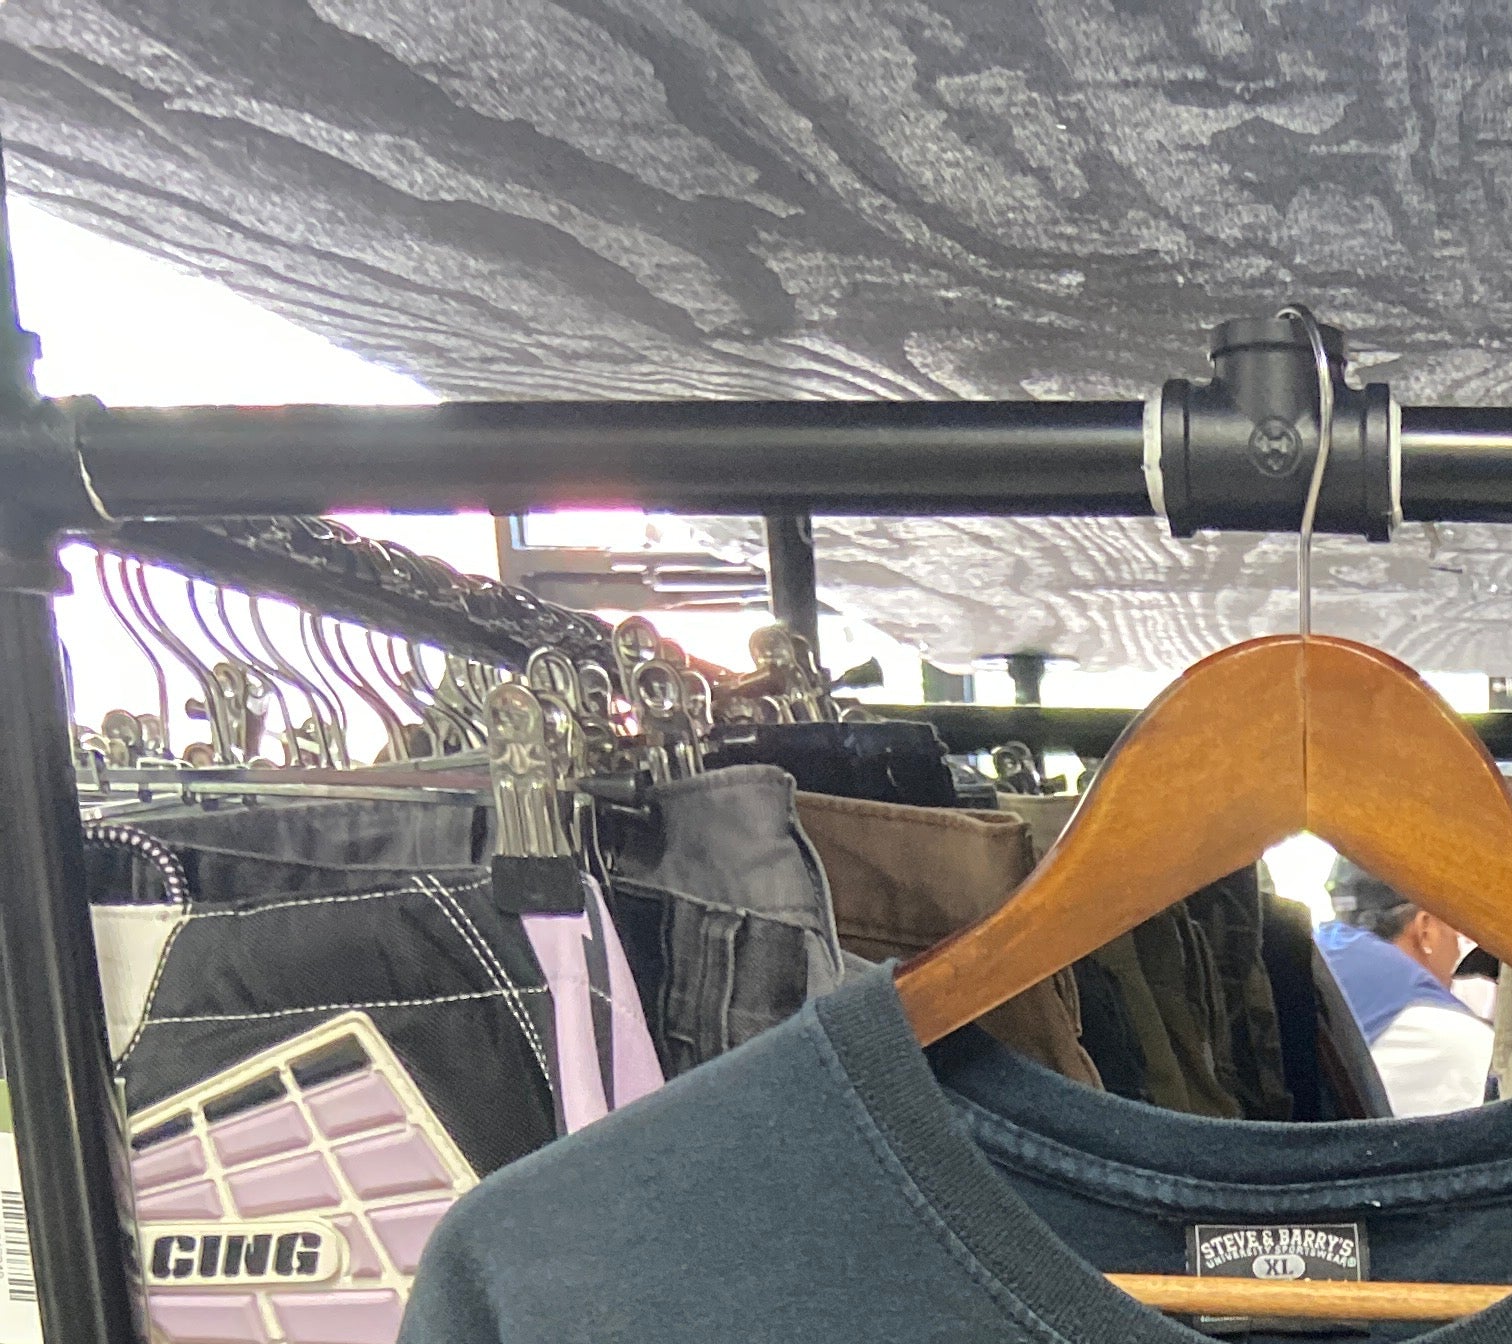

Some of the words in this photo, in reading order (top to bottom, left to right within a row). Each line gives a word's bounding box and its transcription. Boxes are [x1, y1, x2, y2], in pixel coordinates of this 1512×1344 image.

[151, 1232, 322, 1279] CING
[1200, 1231, 1257, 1260] STEVE
[1262, 1230, 1274, 1247] &
[1278, 1228, 1355, 1257] BARRY'S
[1205, 1245, 1272, 1269] UNIVERSITY
[1264, 1258, 1295, 1276] XL
